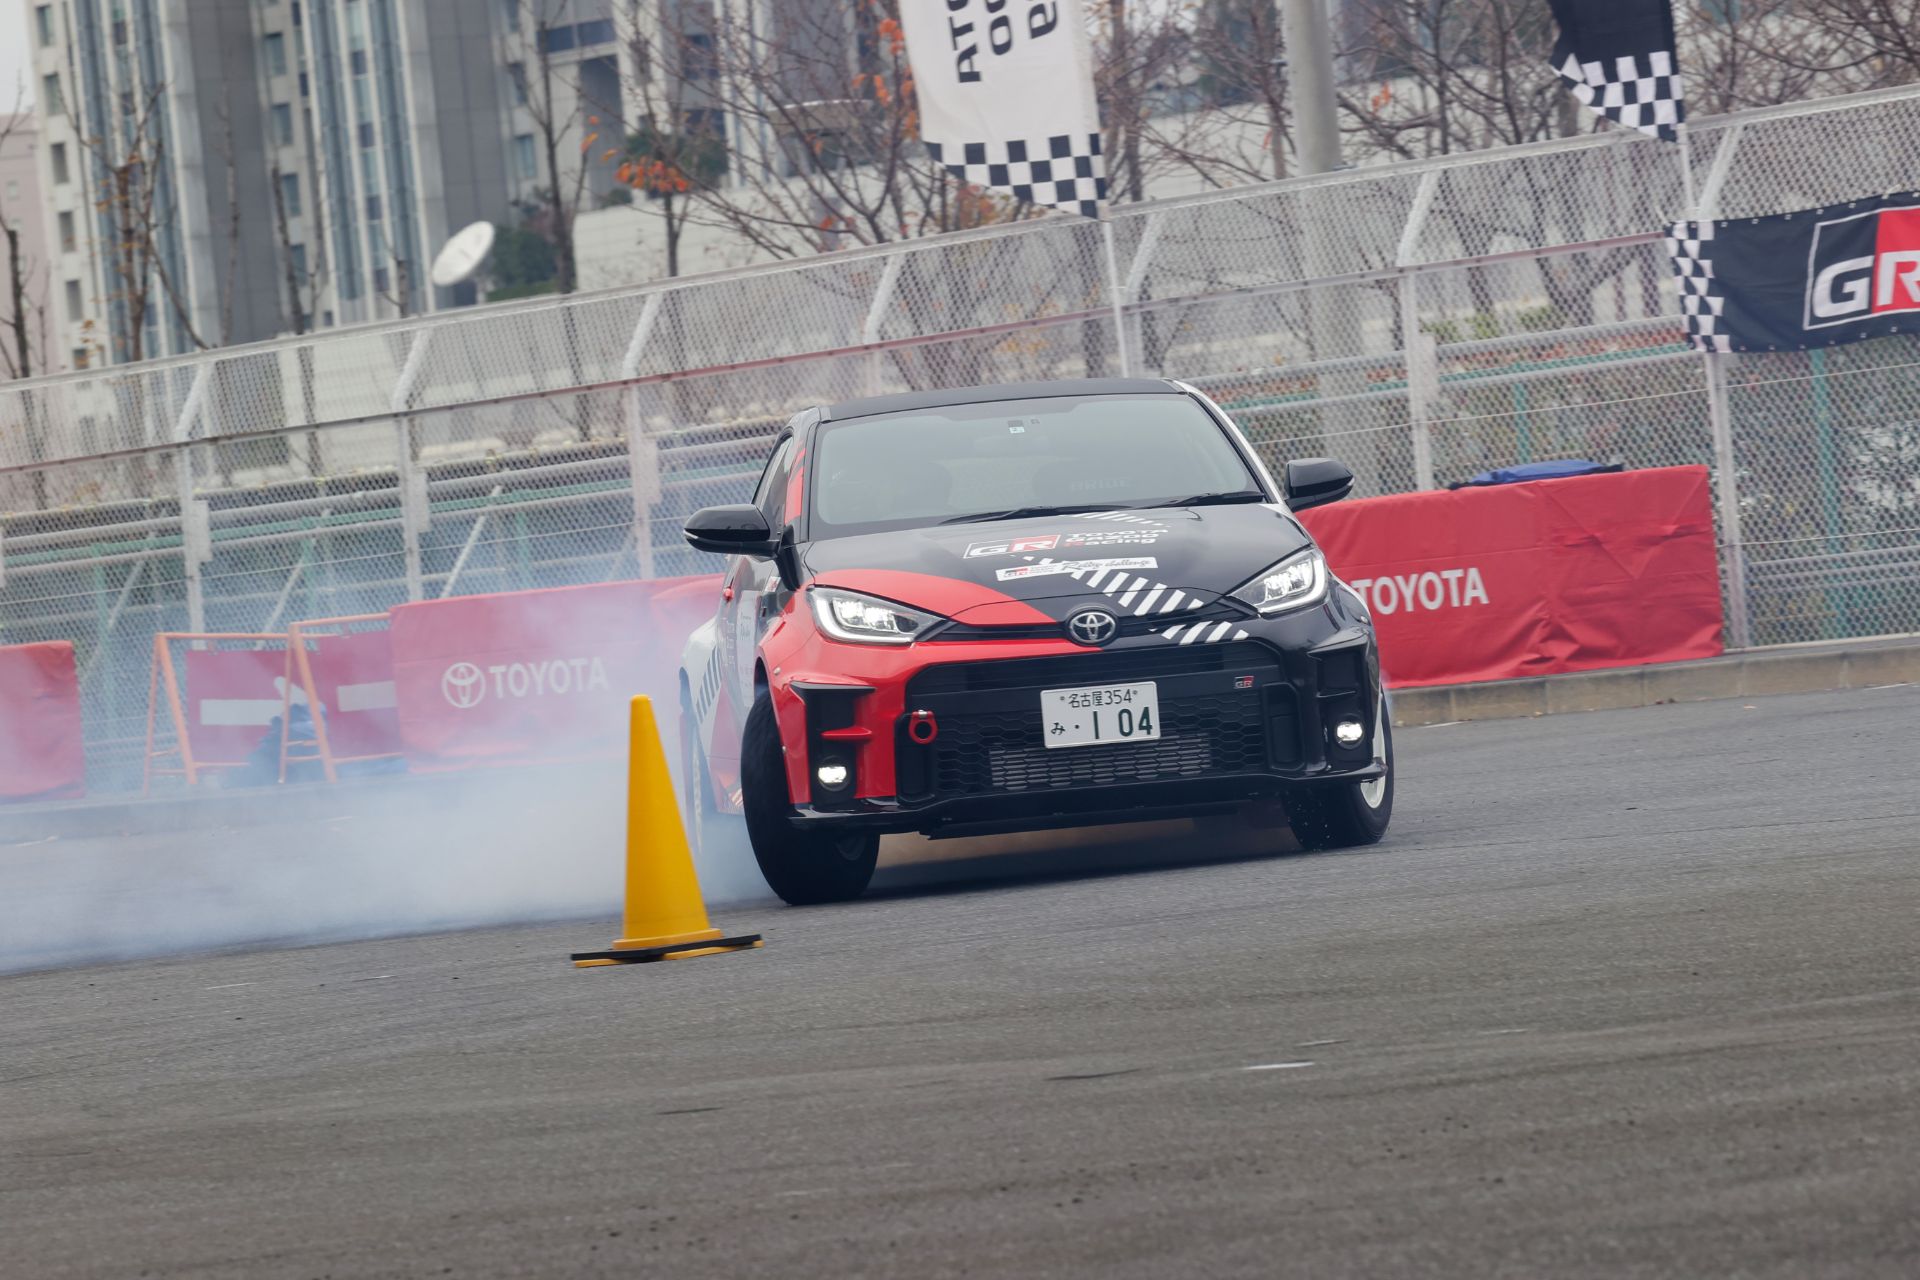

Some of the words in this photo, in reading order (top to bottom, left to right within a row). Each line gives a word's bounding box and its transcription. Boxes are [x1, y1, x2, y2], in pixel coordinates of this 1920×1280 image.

[1065, 533, 1160, 543] GAZOO
[1067, 529, 1169, 538] TOYOTA
[968, 541, 1053, 556] GR
[1064, 538, 1156, 547] Racing
[1350, 567, 1490, 615] TOYOTA
[488, 656, 609, 699] TOYOTA
